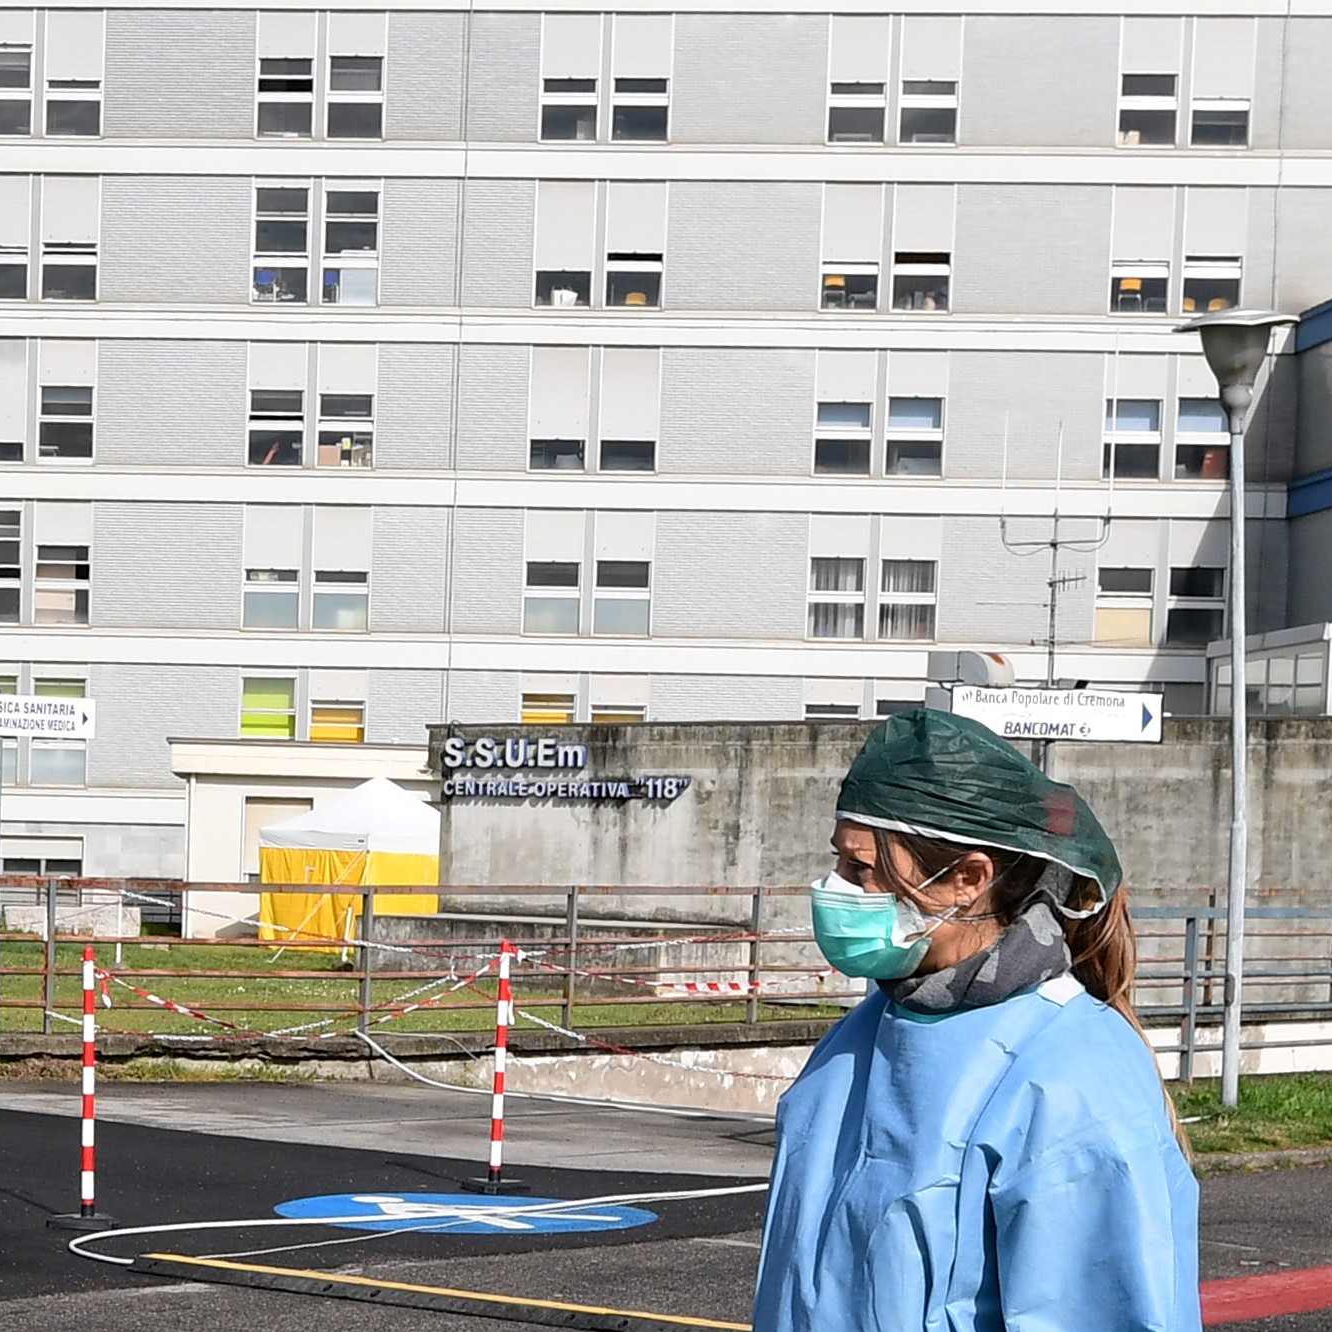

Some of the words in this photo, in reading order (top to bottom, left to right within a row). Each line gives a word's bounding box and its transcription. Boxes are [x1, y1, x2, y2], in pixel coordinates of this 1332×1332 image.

[975, 689, 1007, 704] Banca
[1012, 691, 1059, 707] Popolare
[1064, 693, 1074, 706] di
[1077, 694, 1125, 708] Cremona
[23, 702, 75, 716] SANITARIA
[1004, 721, 1076, 737] BANCOMAT
[444, 780, 528, 797] CENTRALE
[534, 779, 627, 798] OPERATIVA
